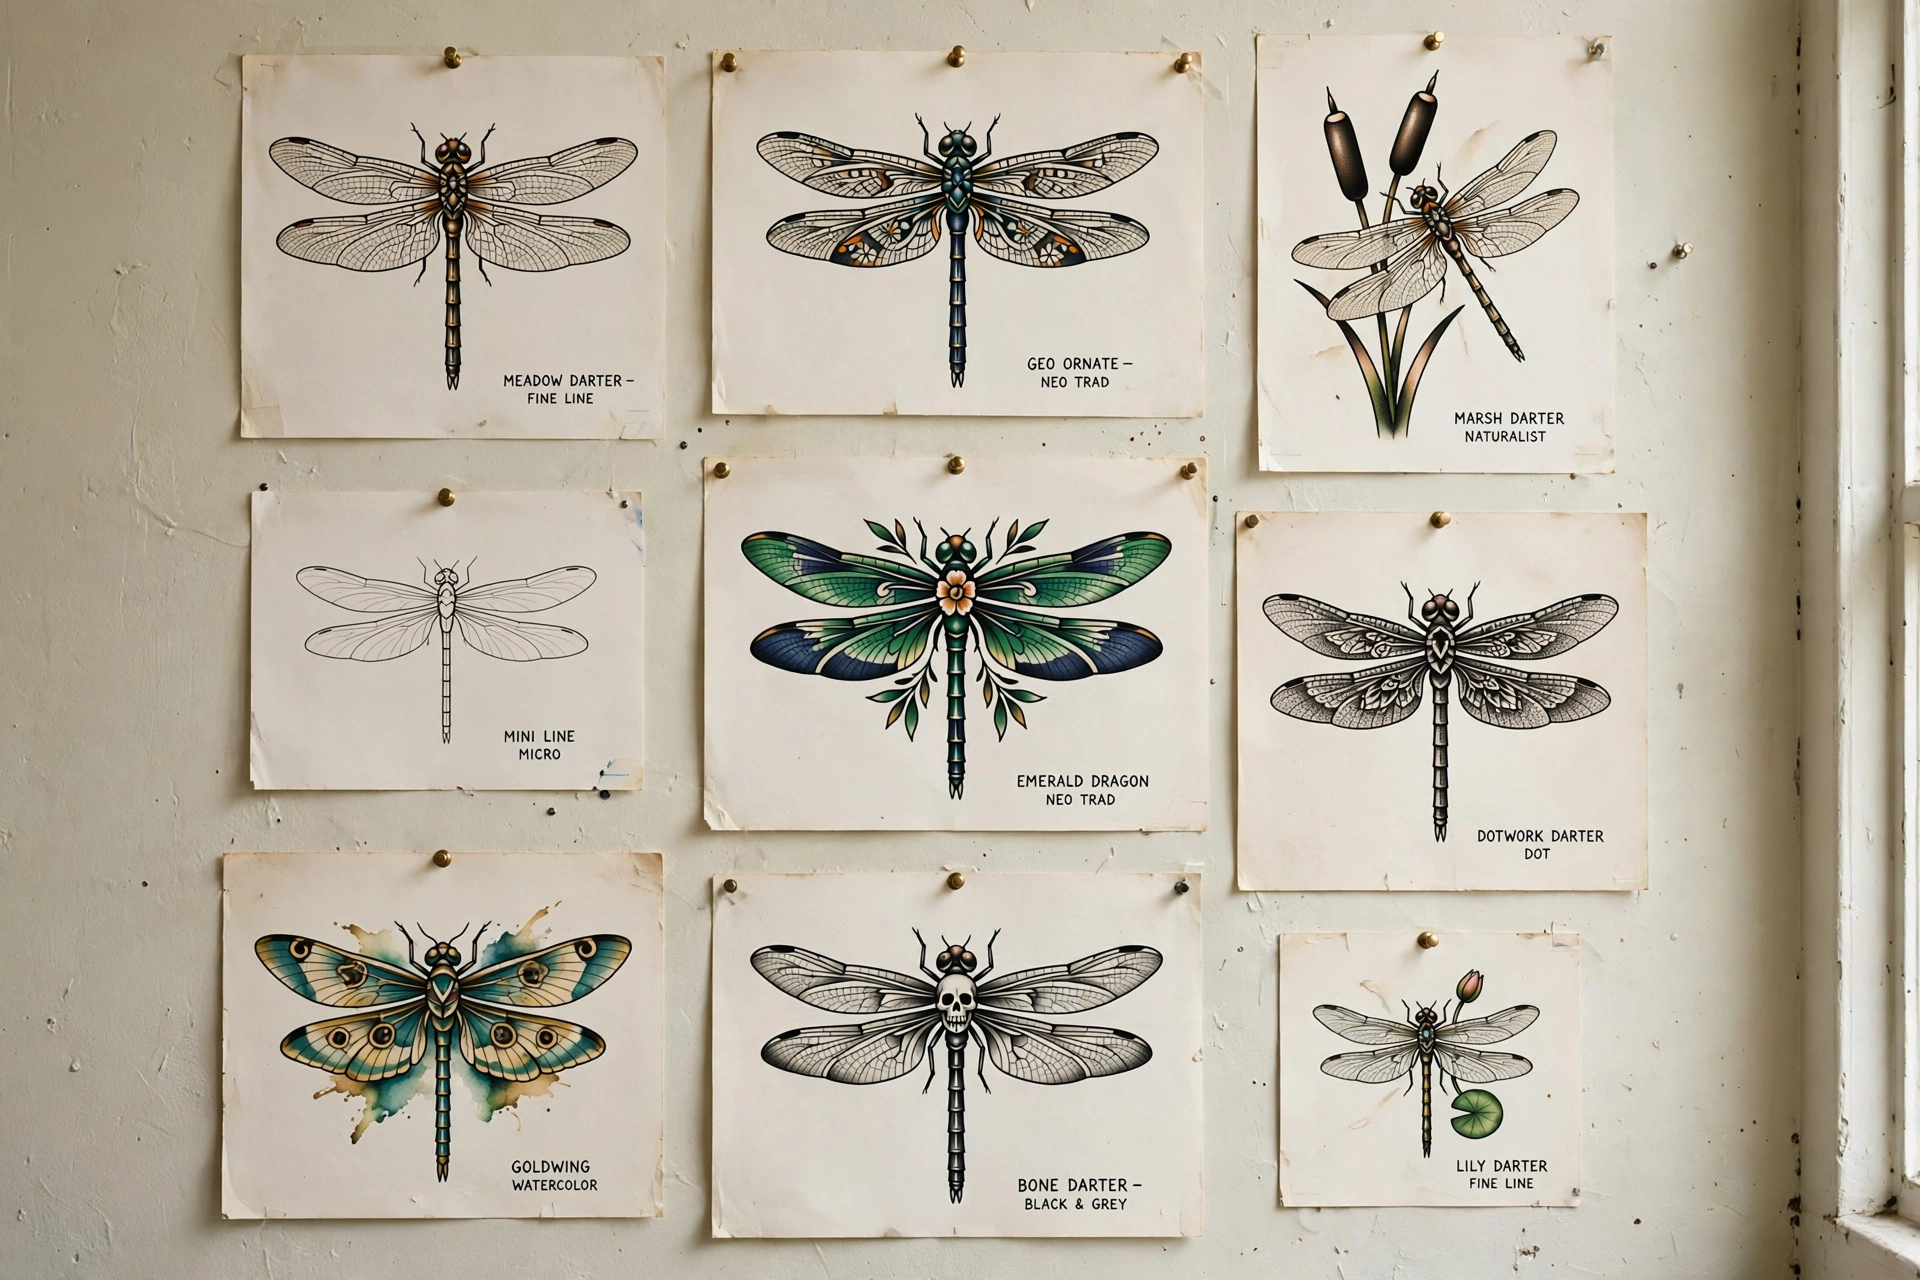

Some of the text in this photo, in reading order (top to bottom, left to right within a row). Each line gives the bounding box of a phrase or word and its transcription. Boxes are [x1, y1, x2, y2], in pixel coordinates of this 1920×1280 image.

[1028, 357, 1054, 370] GEO
[504, 374, 562, 387] MEADOW
[1042, 376, 1109, 388] NEO TRAD
[528, 393, 593, 404] FINE LINE
[1455, 412, 1564, 424] MARSH DARTER
[1466, 430, 1546, 442] NATURALIST
[505, 730, 575, 743] MINI LINE
[519, 749, 560, 760] MICRO
[1018, 775, 1149, 787] EMERALD DRAGON
[1047, 794, 1115, 806] NEO TRAD
[1478, 830, 1604, 842] DOTWORK DARTER
[1525, 848, 1550, 859] DOT
[512, 1160, 590, 1173] GOLDWING
[1457, 1160, 1548, 1172] LILY DARTER
[512, 1179, 598, 1191] WATERCOLOR
[1019, 1179, 1058, 1192] BONE
[1470, 1178, 1533, 1189] FINE LINE
[1025, 1198, 1128, 1210] BLACK & GREY
